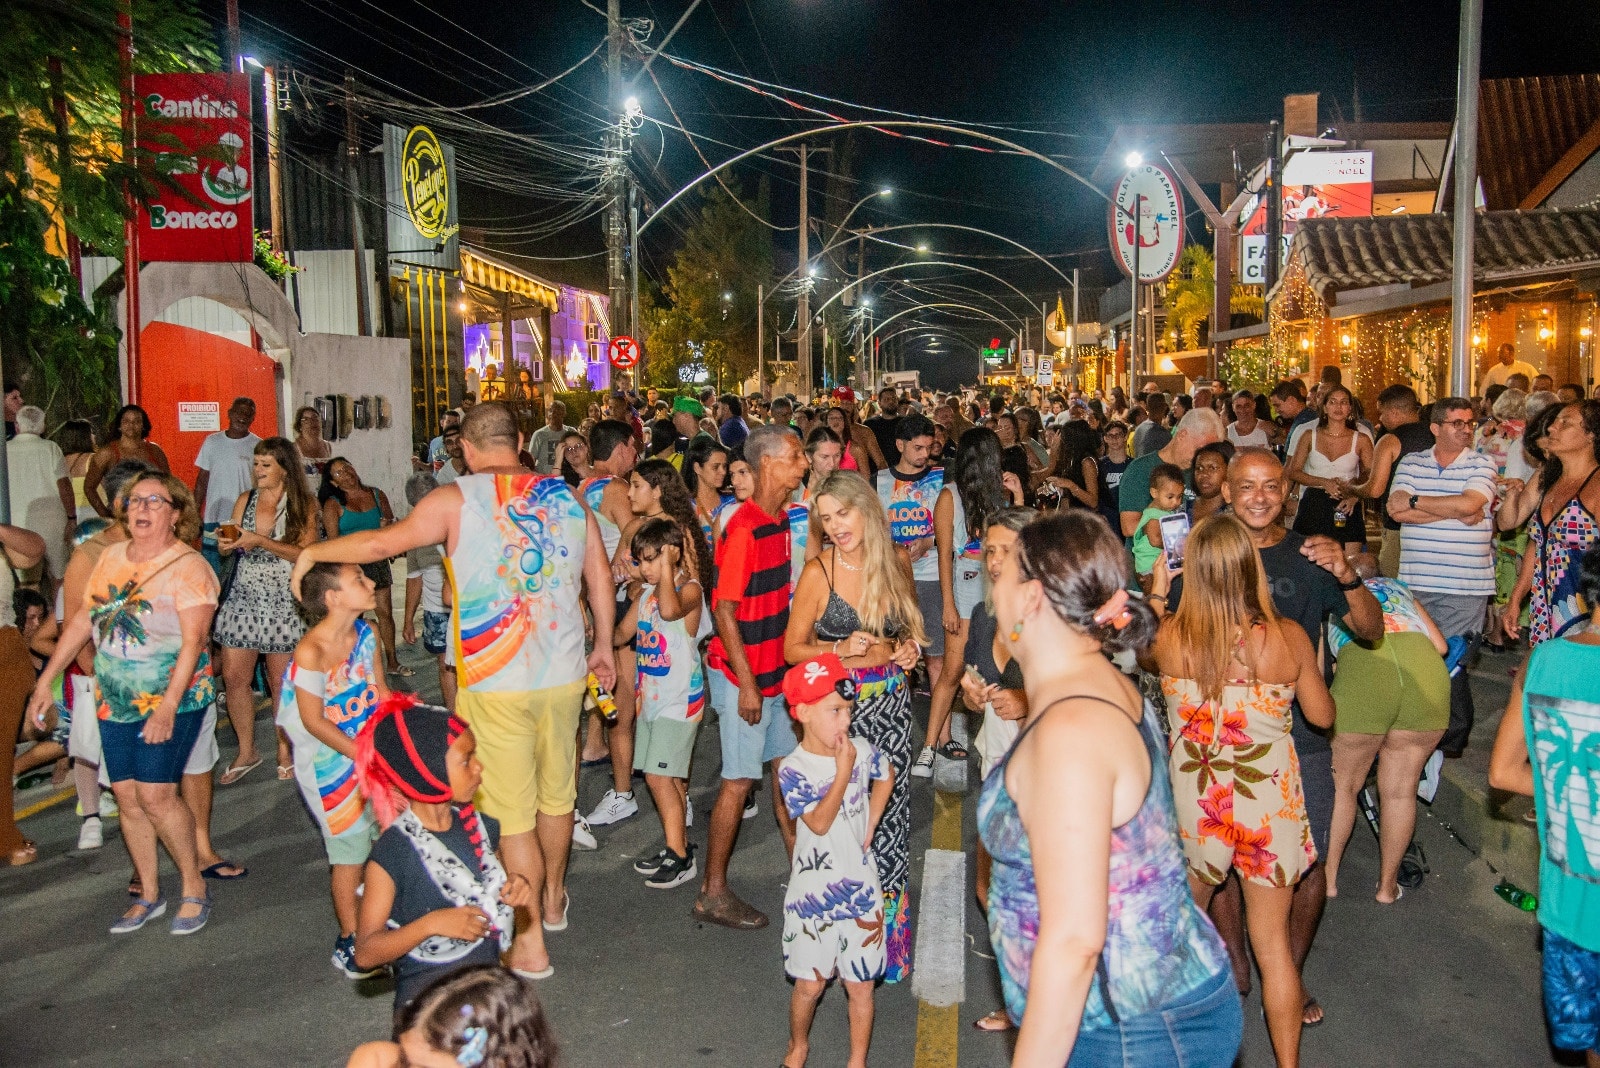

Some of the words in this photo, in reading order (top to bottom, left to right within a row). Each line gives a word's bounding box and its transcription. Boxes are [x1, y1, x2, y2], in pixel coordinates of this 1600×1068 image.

[144, 93, 238, 118] Cantina
[1116, 171, 1137, 233] CHOOLATE
[1154, 169, 1171, 199] PAPAI
[1169, 202, 1178, 230] NOEL
[149, 205, 238, 229] Boneco
[1042, 362, 1048, 370] E
[181, 404, 217, 412] PROIBIDO
